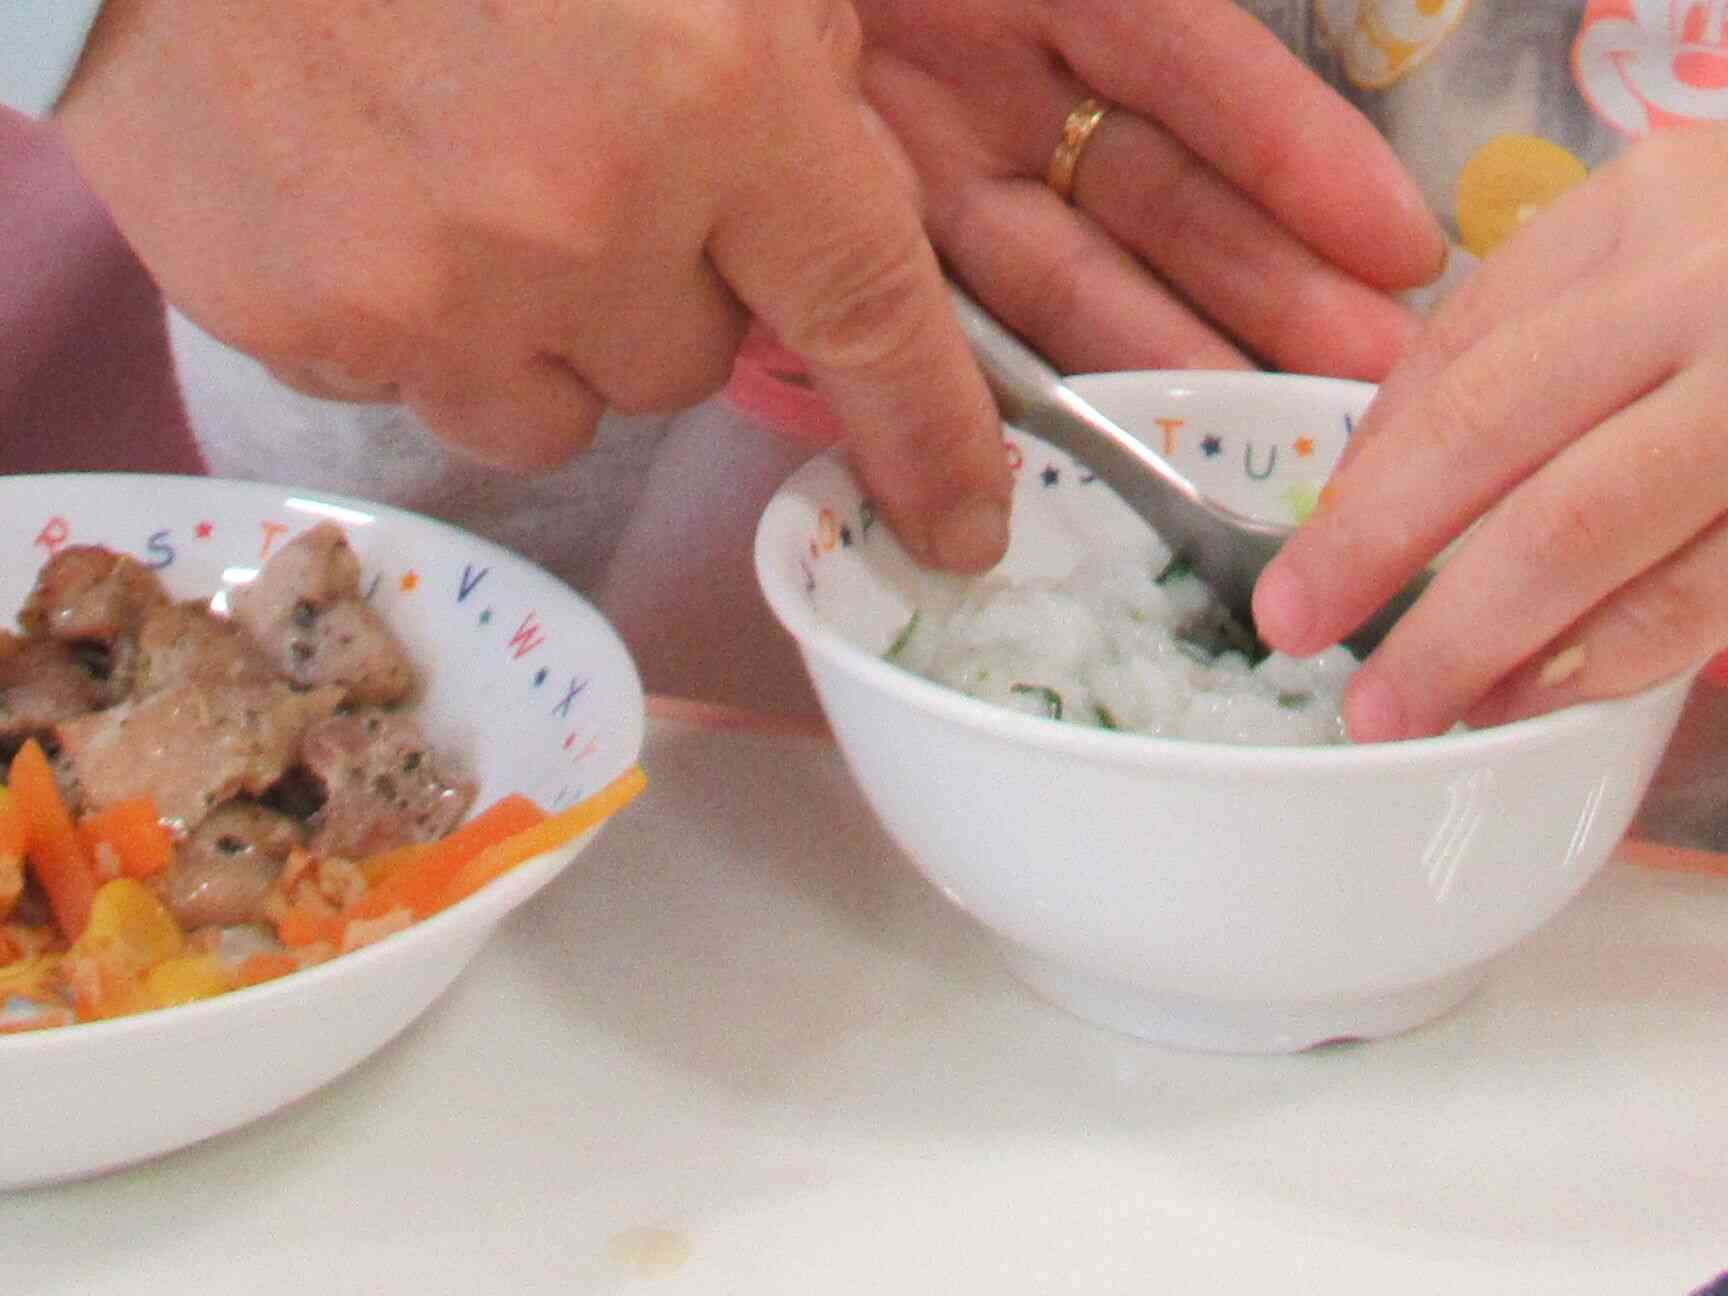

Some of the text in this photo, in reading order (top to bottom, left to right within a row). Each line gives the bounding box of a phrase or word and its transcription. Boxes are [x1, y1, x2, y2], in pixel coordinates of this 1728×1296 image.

[1154, 417, 1184, 455] T
[147, 529, 176, 569] S
[260, 520, 289, 561] T
